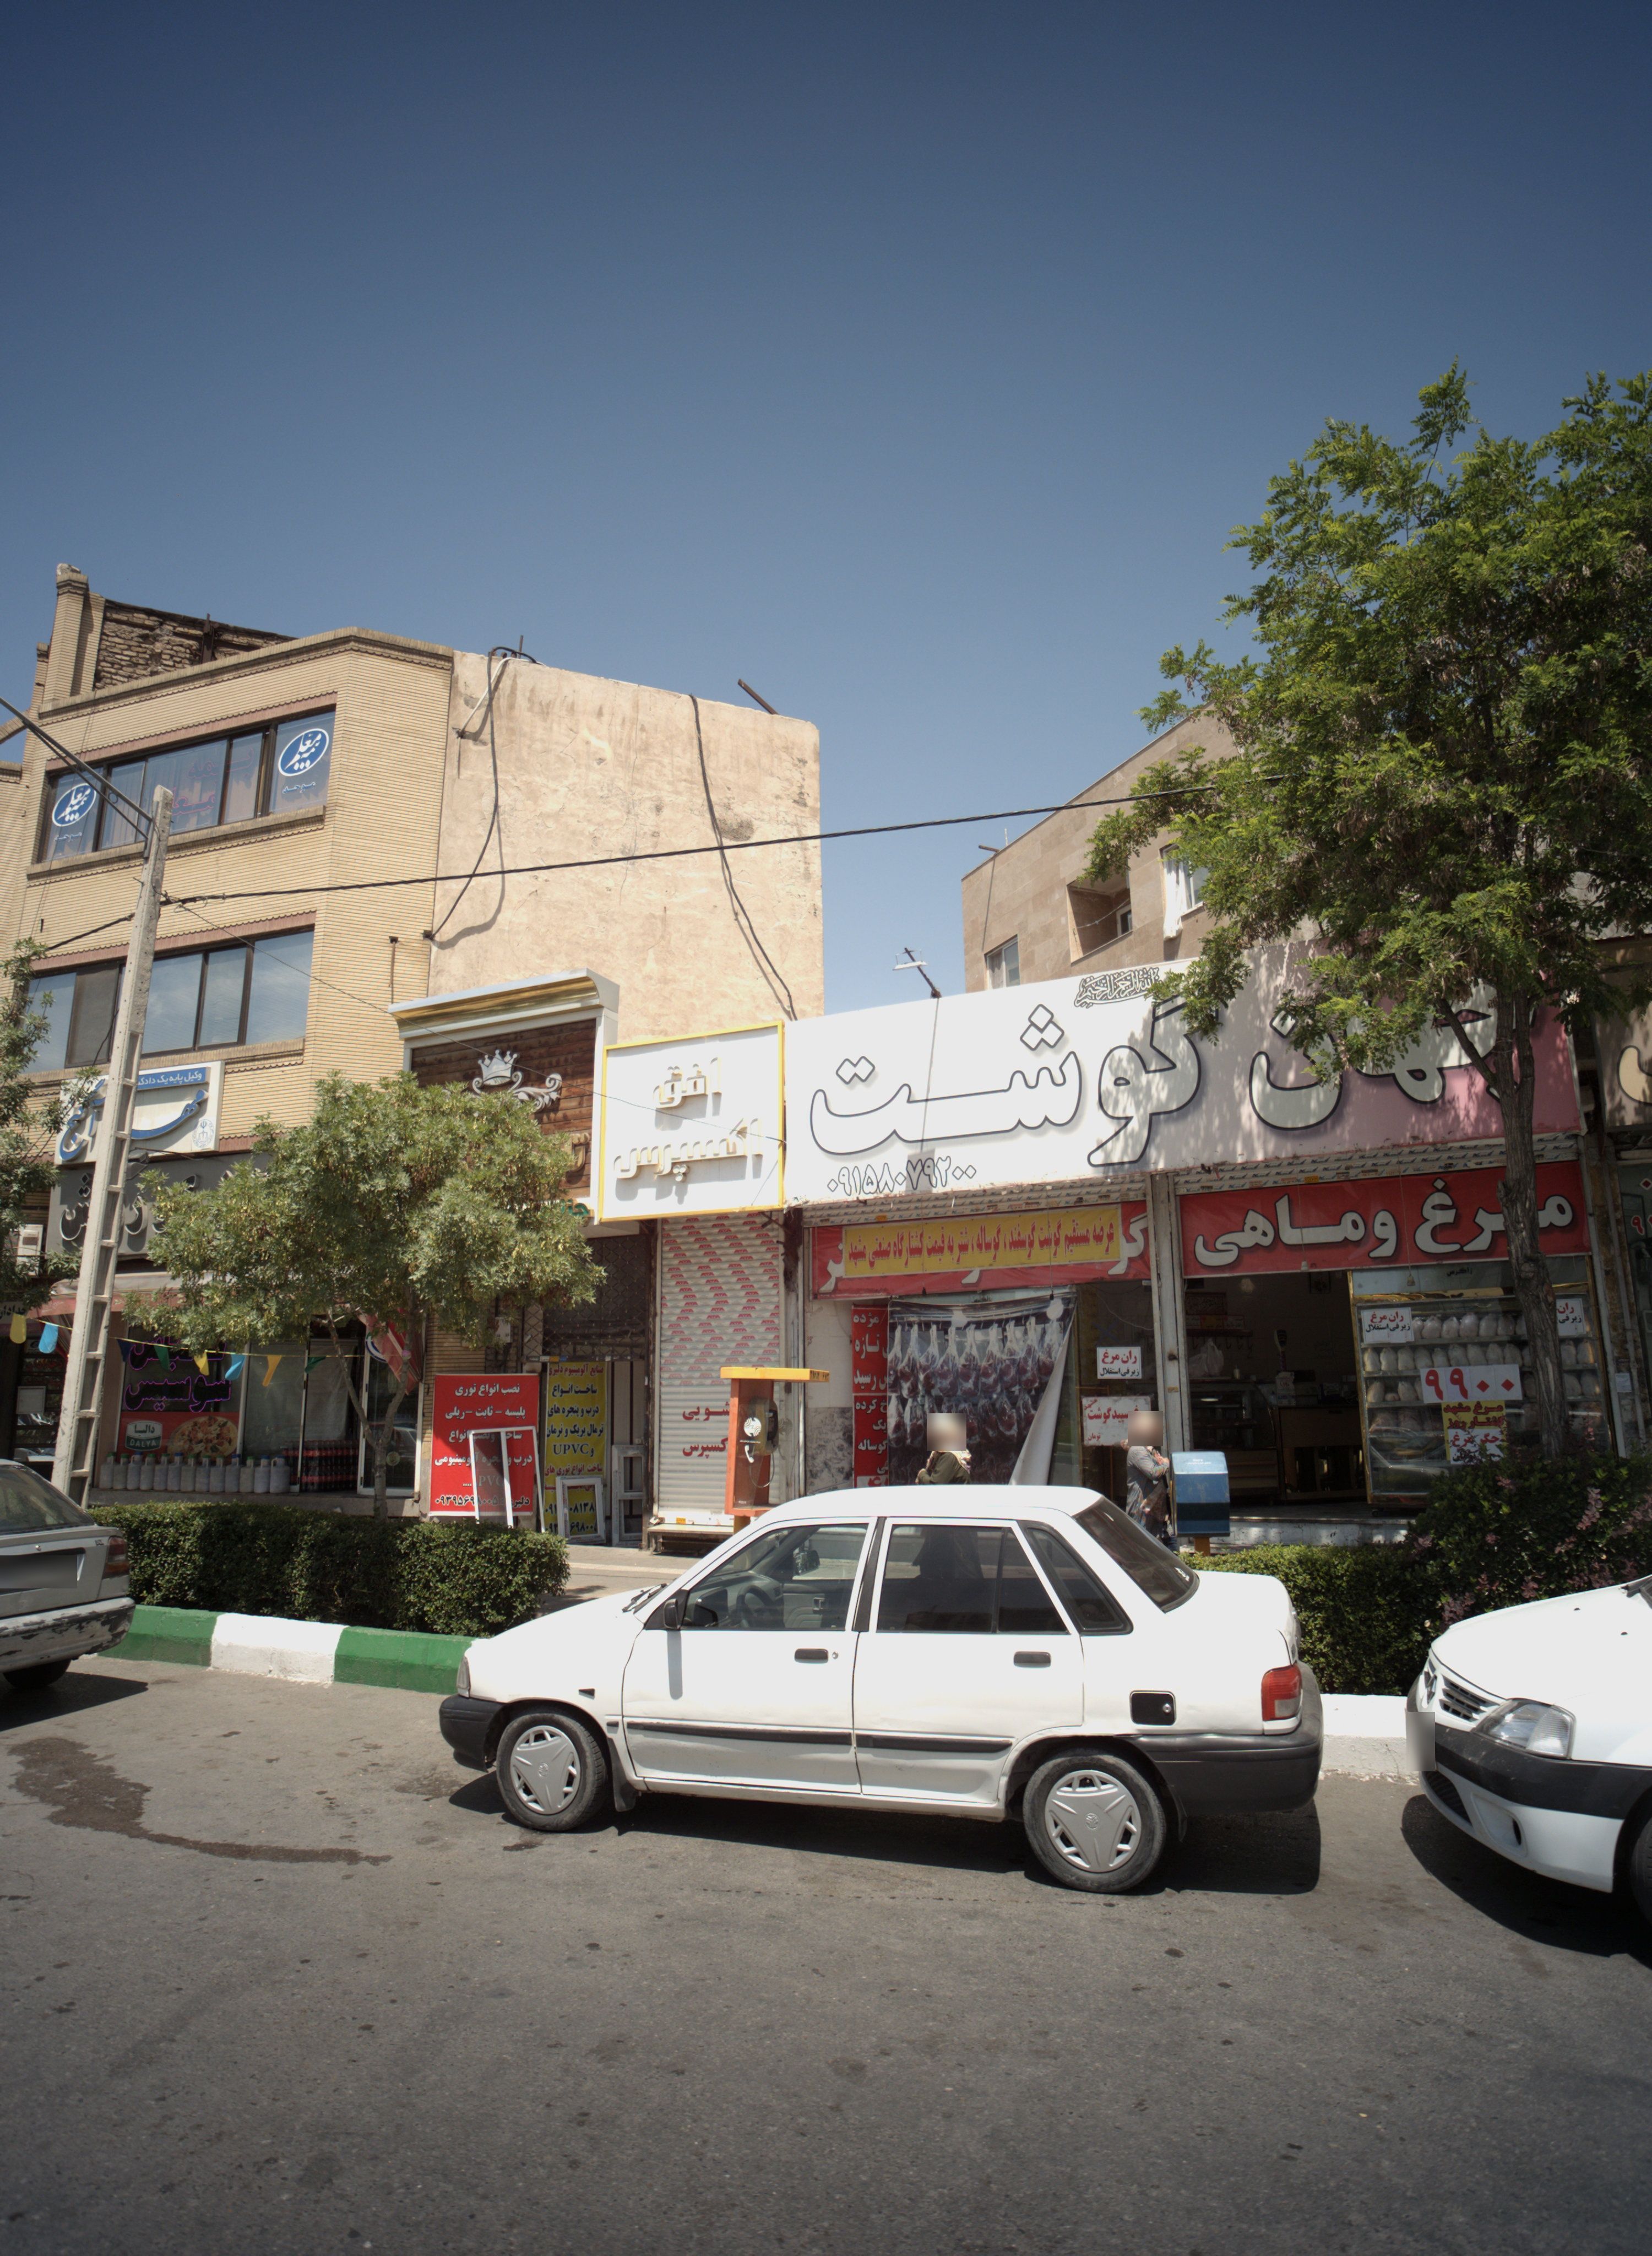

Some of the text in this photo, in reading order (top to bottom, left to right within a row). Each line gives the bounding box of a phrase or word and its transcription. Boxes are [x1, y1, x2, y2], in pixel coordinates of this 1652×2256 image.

[157, 1075, 168, 1084] یک
[169, 1072, 183, 1084] پایه
[184, 1071, 202, 1082] وکیل
[653, 1057, 721, 1109] افق
[811, 991, 1218, 1167] گوشت
[613, 1118, 763, 1183] اکسپرس
[827, 1156, 976, 1196] ۰۹۱۵۸۰۷۹۲۰۰
[1415, 1178, 1574, 1254] مرغ
[976, 1224, 1001, 1261] گوساله
[1009, 1221, 1035, 1259] گوسفند
[1038, 1219, 1061, 1257] گوشت
[1064, 1219, 1090, 1257] مستقیم
[1093, 1217, 1114, 1254] عرضه
[849, 1234, 867, 1267] مشهد
[926, 1226, 945, 1262] قیمت
[948, 1234, 954, 1261] به
[957, 1227, 969, 1264] شتر
[868, 1237, 892, 1270] صنعتی
[854, 1313, 879, 1327] مژده
[1370, 1311, 1404, 1323] ران مرغ
[855, 1333, 880, 1359] تازه
[1102, 1349, 1137, 1364] ران مرغ
[854, 1369, 877, 1391] رسید
[124, 1375, 231, 1412] سوسیس
[455, 1384, 520, 1396] نصب انواع توری
[552, 1384, 597, 1397] ساخت انواع
[475, 1405, 493, 1418] ثابت
[504, 1406, 525, 1419] پلیسه
[547, 1404, 560, 1417] های
[562, 1406, 579, 1417] پنجره
[586, 1406, 599, 1417] درب
[856, 1398, 877, 1413] کرده
[1443, 1401, 1504, 1416] مرغ مشهد
[449, 1430, 470, 1442] انواع
[570, 1424, 585, 1437] بریک
[588, 1424, 604, 1437] ترمال
[130, 1439, 156, 1448] DALYA
[553, 1443, 589, 1455] UPVC
[682, 1437, 729, 1459] کسپرس
[514, 1455, 532, 1466] درب
[588, 1463, 602, 1473] ساخت
[571, 1465, 584, 1476] انواع
[512, 1495, 530, 1508] دلیر
